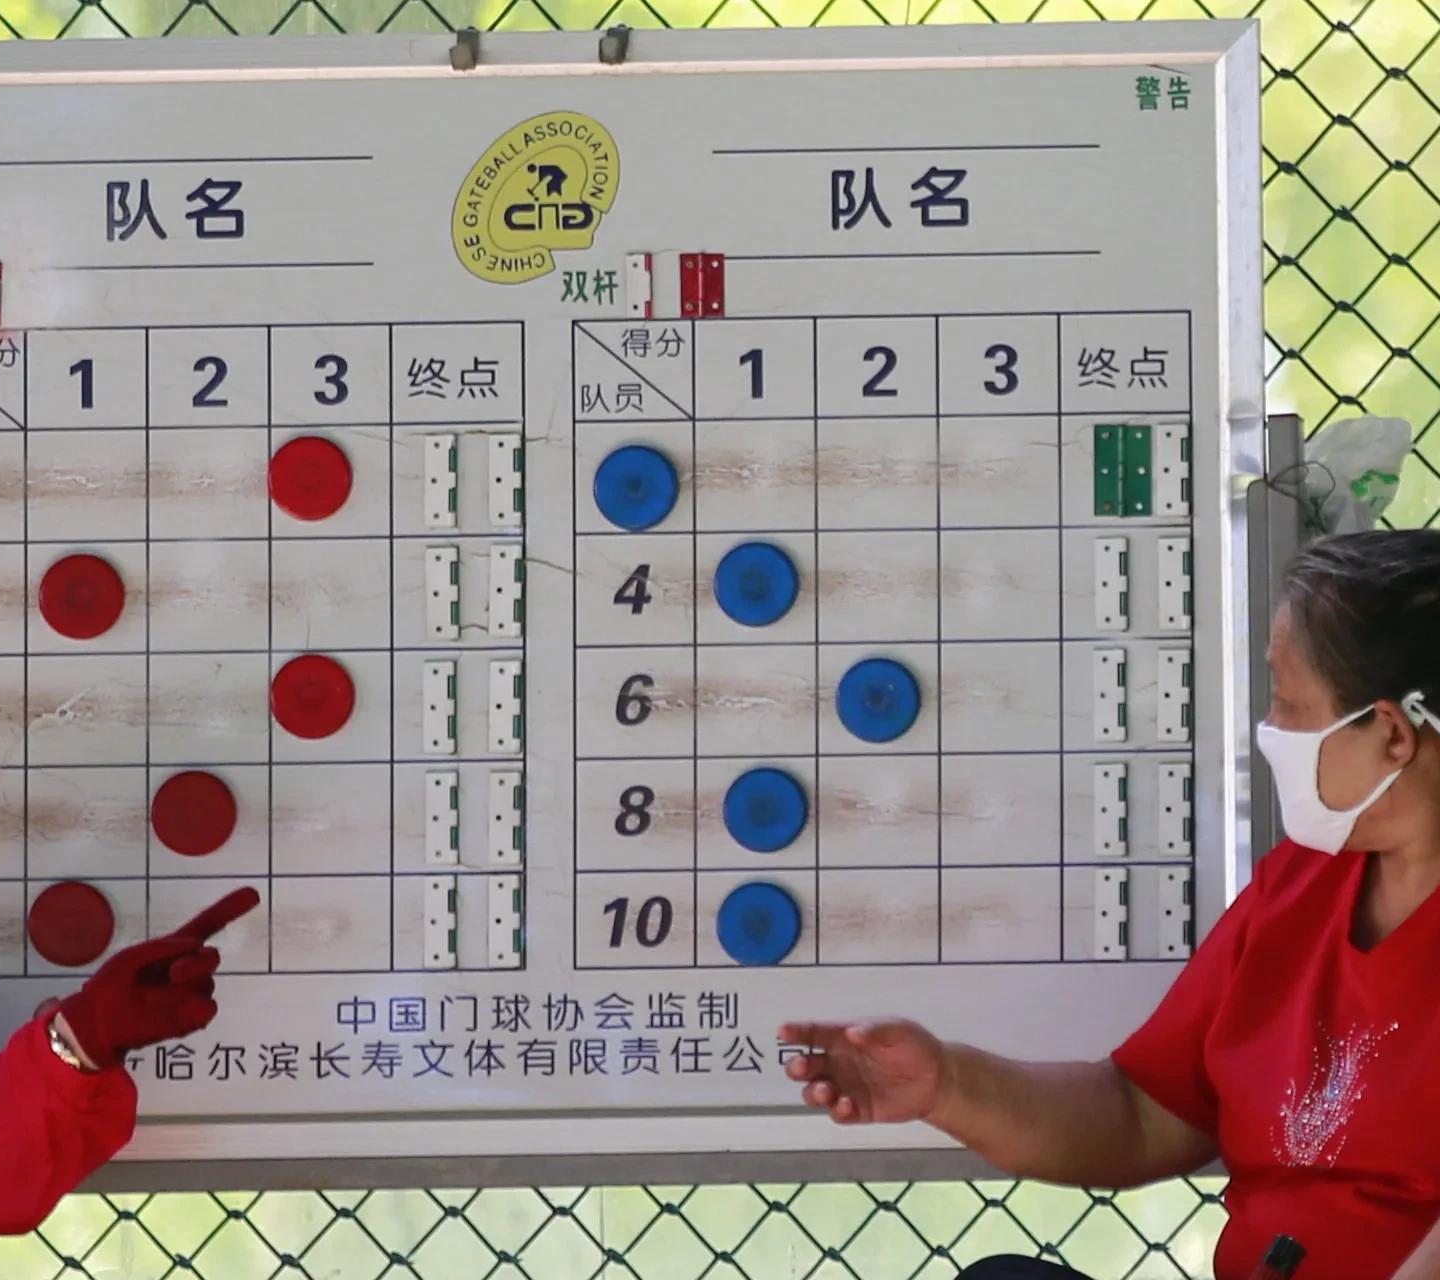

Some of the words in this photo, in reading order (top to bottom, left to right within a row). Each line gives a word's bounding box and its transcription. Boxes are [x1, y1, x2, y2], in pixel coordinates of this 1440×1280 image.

[1135, 76, 1191, 111] 警告
[463, 142, 523, 228] GATEBALL
[522, 120, 609, 201] ASSOCIATION
[106, 177, 245, 241] 队名
[831, 166, 970, 230] 队名
[464, 234, 546, 272] CHINESE
[560, 269, 619, 306] 双杆
[621, 327, 685, 358] 得分
[1077, 345, 1169, 389] 终点
[70, 358, 94, 409] 1
[192, 356, 229, 408] 2
[313, 354, 349, 406] 3
[407, 356, 500, 399] 终点
[739, 348, 764, 399] 1
[861, 346, 899, 398] 2
[983, 344, 1020, 396] 3
[580, 383, 644, 414] 队员
[614, 563, 653, 615] 4
[615, 673, 654, 726] 6
[614, 785, 654, 837] 8
[603, 895, 674, 948] 10
[337, 992, 740, 1034] 中国门球协会监制
